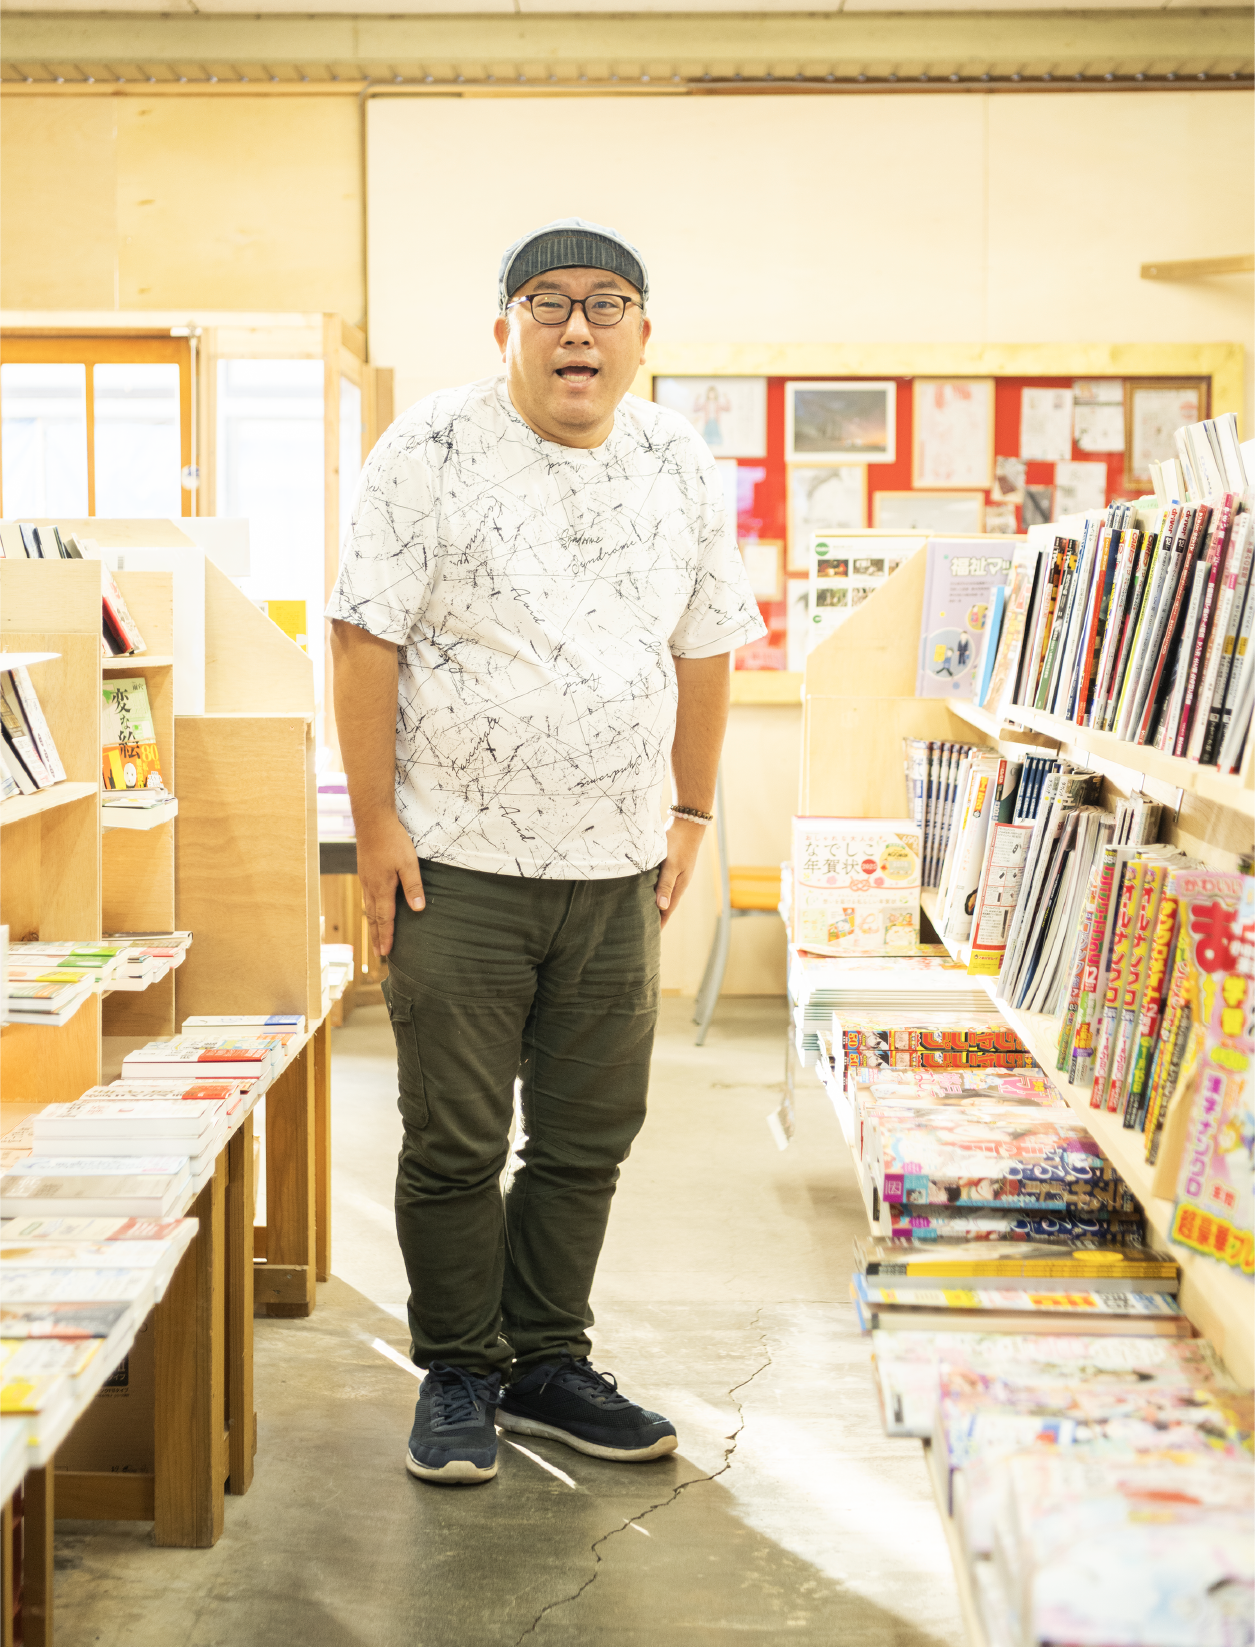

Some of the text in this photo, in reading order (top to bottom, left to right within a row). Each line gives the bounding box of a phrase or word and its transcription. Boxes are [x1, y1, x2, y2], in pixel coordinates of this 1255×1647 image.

[1168, 508, 1178, 534] driver
[1181, 510, 1191, 536] driver
[112, 688, 140, 759] 変な絵
[141, 744, 159, 762] 80
[805, 841, 875, 857] なでしこ
[803, 858, 860, 875] 年賀状
[1105, 882, 1136, 1005] オールナンクロ
[1123, 884, 1155, 1008] オールナンクロ
[848, 1032, 859, 1048] 50
